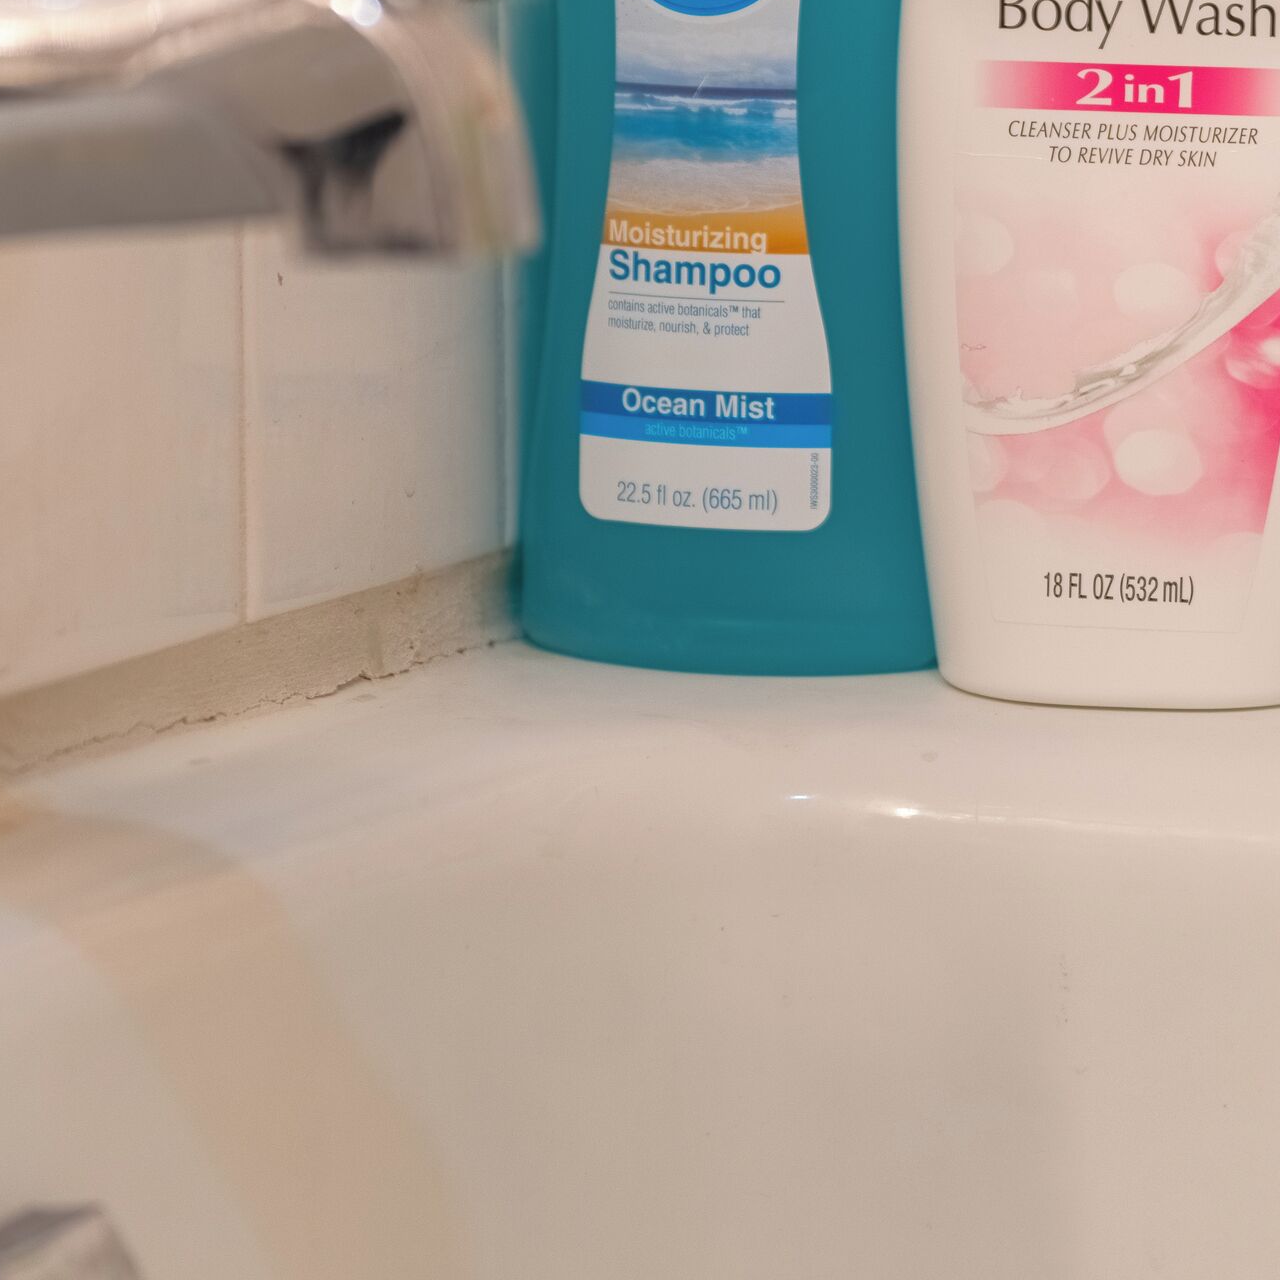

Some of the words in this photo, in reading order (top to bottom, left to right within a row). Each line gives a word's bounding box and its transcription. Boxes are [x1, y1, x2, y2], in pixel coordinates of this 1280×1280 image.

[1008, 120, 1091, 140] CLEANSER
[1097, 123, 1137, 142] PLUS
[1144, 125, 1258, 145] MOISTURIZER
[1049, 145, 1072, 163] TO
[1077, 146, 1133, 166] REVIVE
[1139, 148, 1173, 167] DRY
[1178, 150, 1217, 168] SKIN
[609, 218, 767, 255] Moisturizing
[609, 249, 781, 295] Shampoo
[608, 299, 645, 313] contains
[648, 302, 675, 315] active
[741, 306, 761, 319] that
[608, 316, 656, 333] moisturize,
[659, 321, 699, 336] nourish,
[703, 324, 711, 334] &
[714, 324, 749, 337] protect
[622, 388, 705, 417] Ocean
[715, 394, 775, 420] Mist
[645, 422, 676, 437] active
[617, 480, 651, 505] 22.5
[657, 485, 667, 506] fl
[672, 490, 696, 509] oz.
[702, 487, 742, 513] (665
[749, 489, 778, 515] ml)
[1044, 571, 1063, 598] 18
[1069, 573, 1087, 599] FL
[1093, 574, 1114, 600] OZ
[1120, 573, 1158, 603] (532
[1163, 576, 1194, 605] mL)
